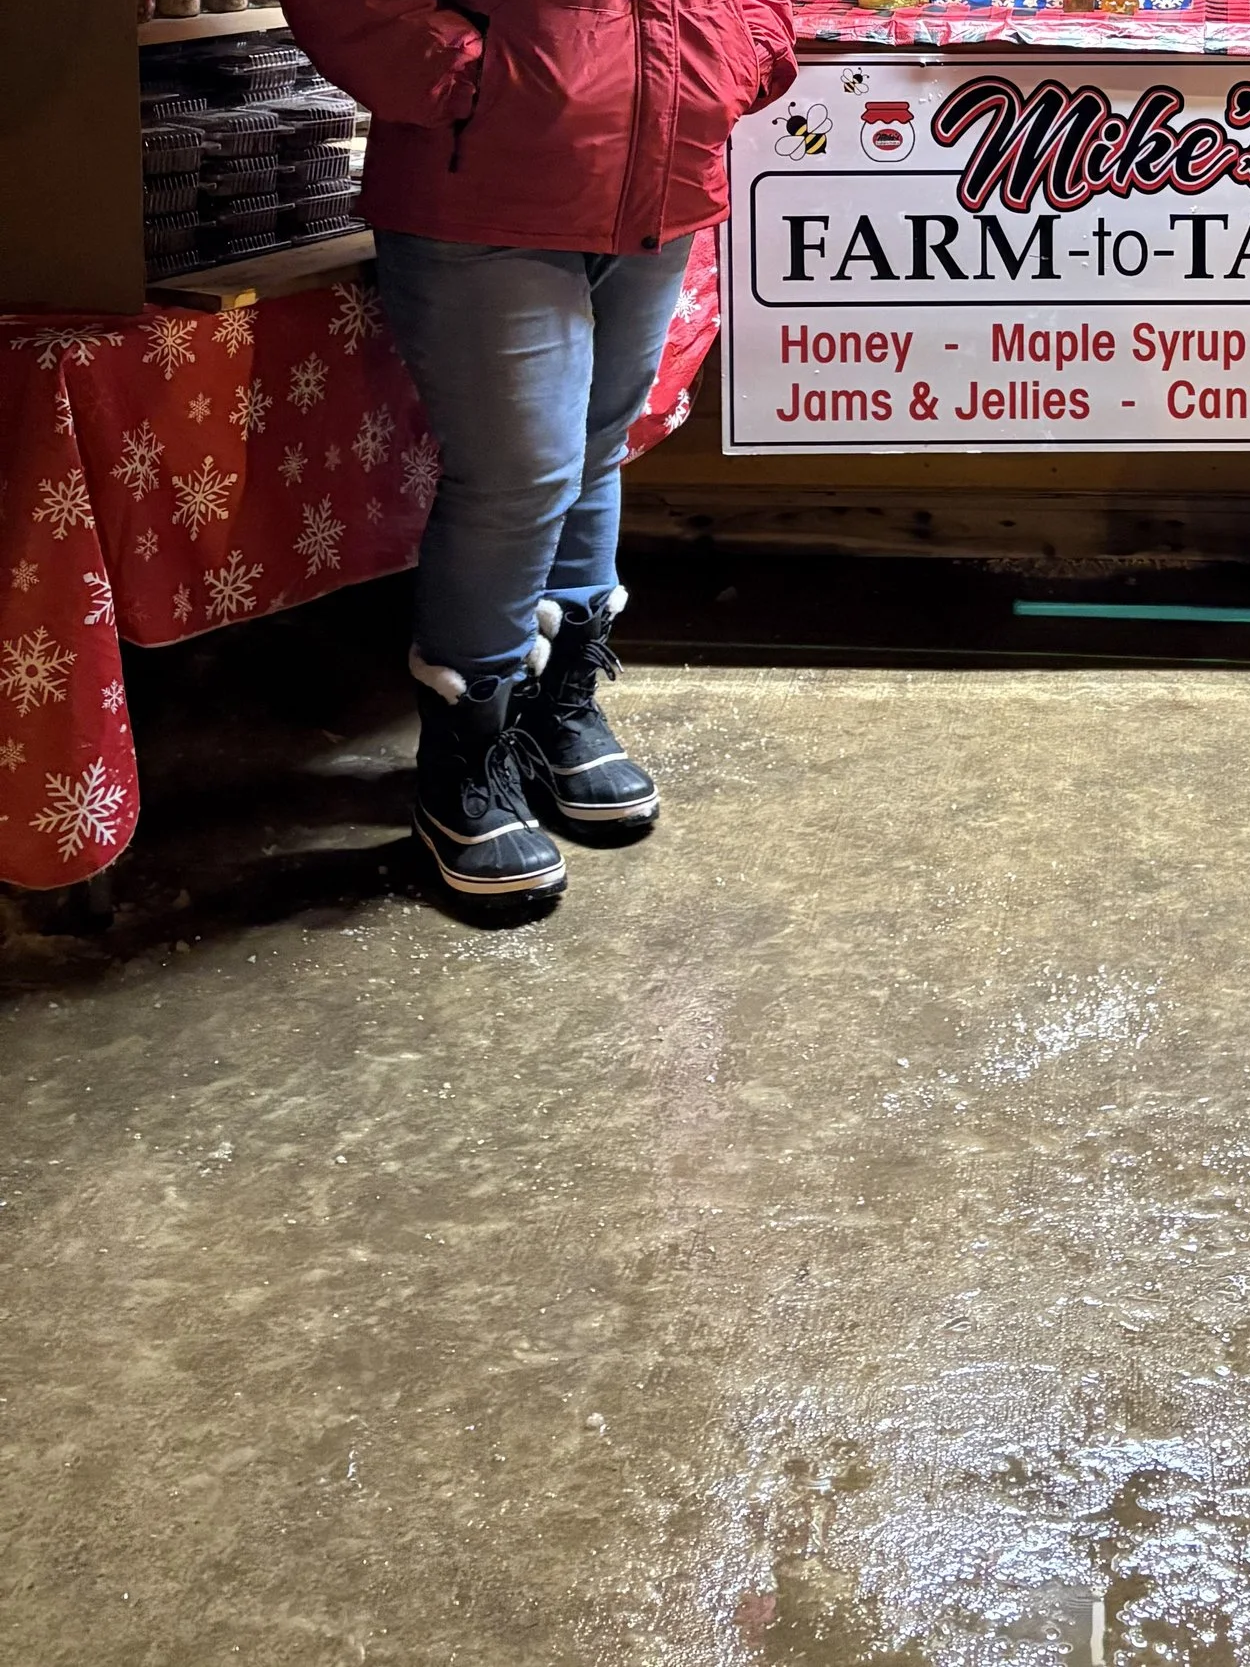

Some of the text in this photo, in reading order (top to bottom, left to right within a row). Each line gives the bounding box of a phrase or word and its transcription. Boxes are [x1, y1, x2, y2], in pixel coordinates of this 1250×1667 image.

[781, 325, 913, 372] Honey
[991, 323, 1116, 371] Maple
[1132, 322, 1246, 371] Syrup
[776, 382, 893, 422] Jams
[909, 381, 938, 421] &
[955, 380, 1090, 420] Jellies
